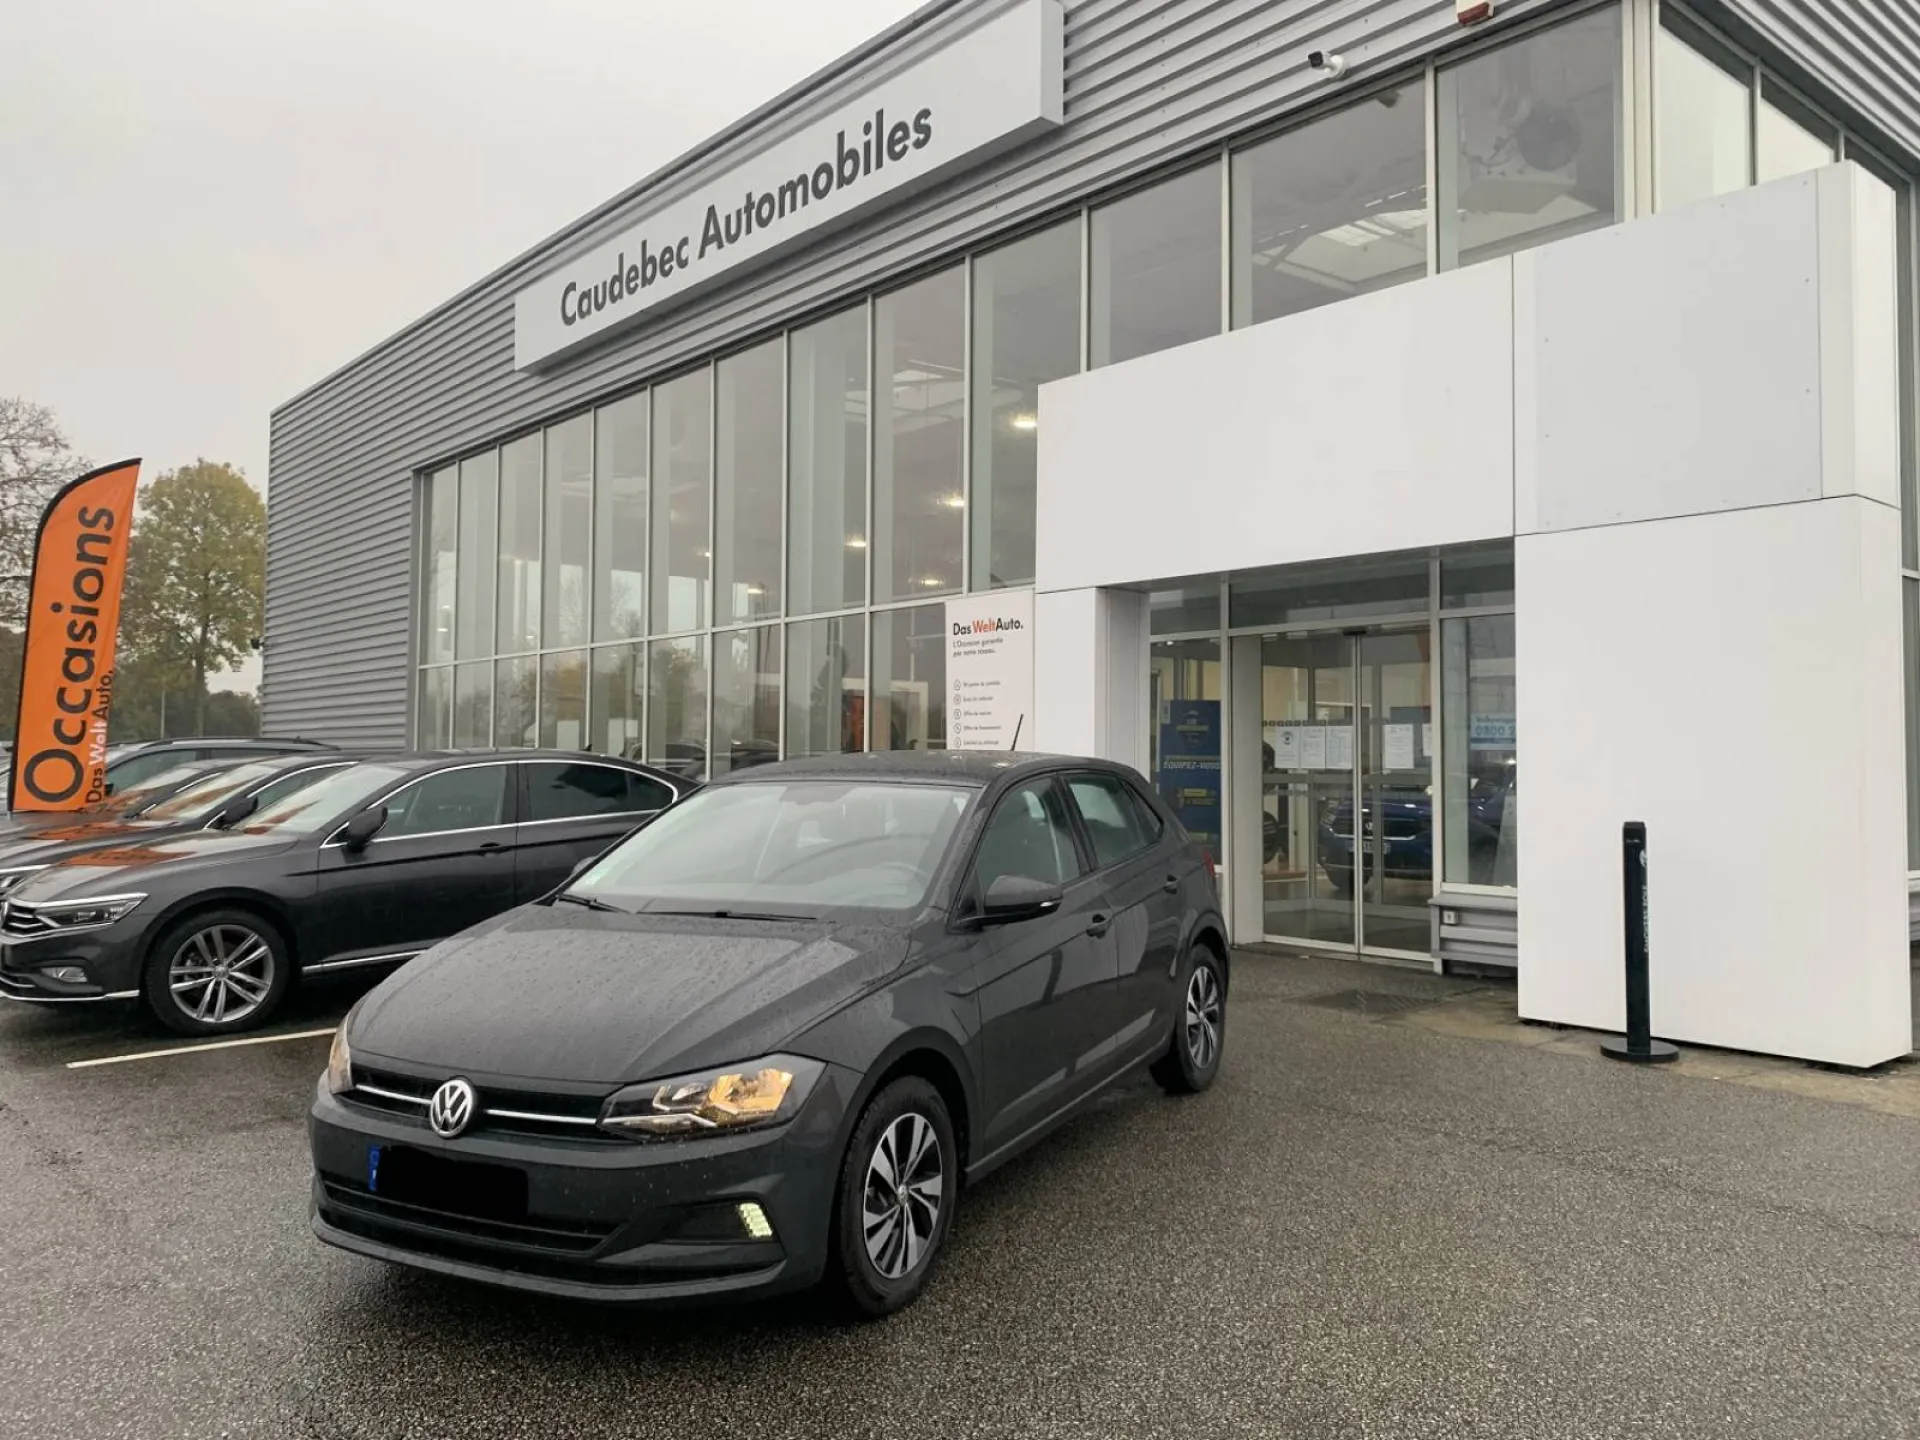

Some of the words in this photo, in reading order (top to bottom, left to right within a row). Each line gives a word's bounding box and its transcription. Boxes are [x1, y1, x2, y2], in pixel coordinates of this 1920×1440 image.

[561, 237, 689, 326] Caudebec
[698, 107, 933, 260] Automobiles
[24, 505, 114, 803] Occasions
[953, 622, 971, 636] Das
[85, 767, 103, 804] Das
